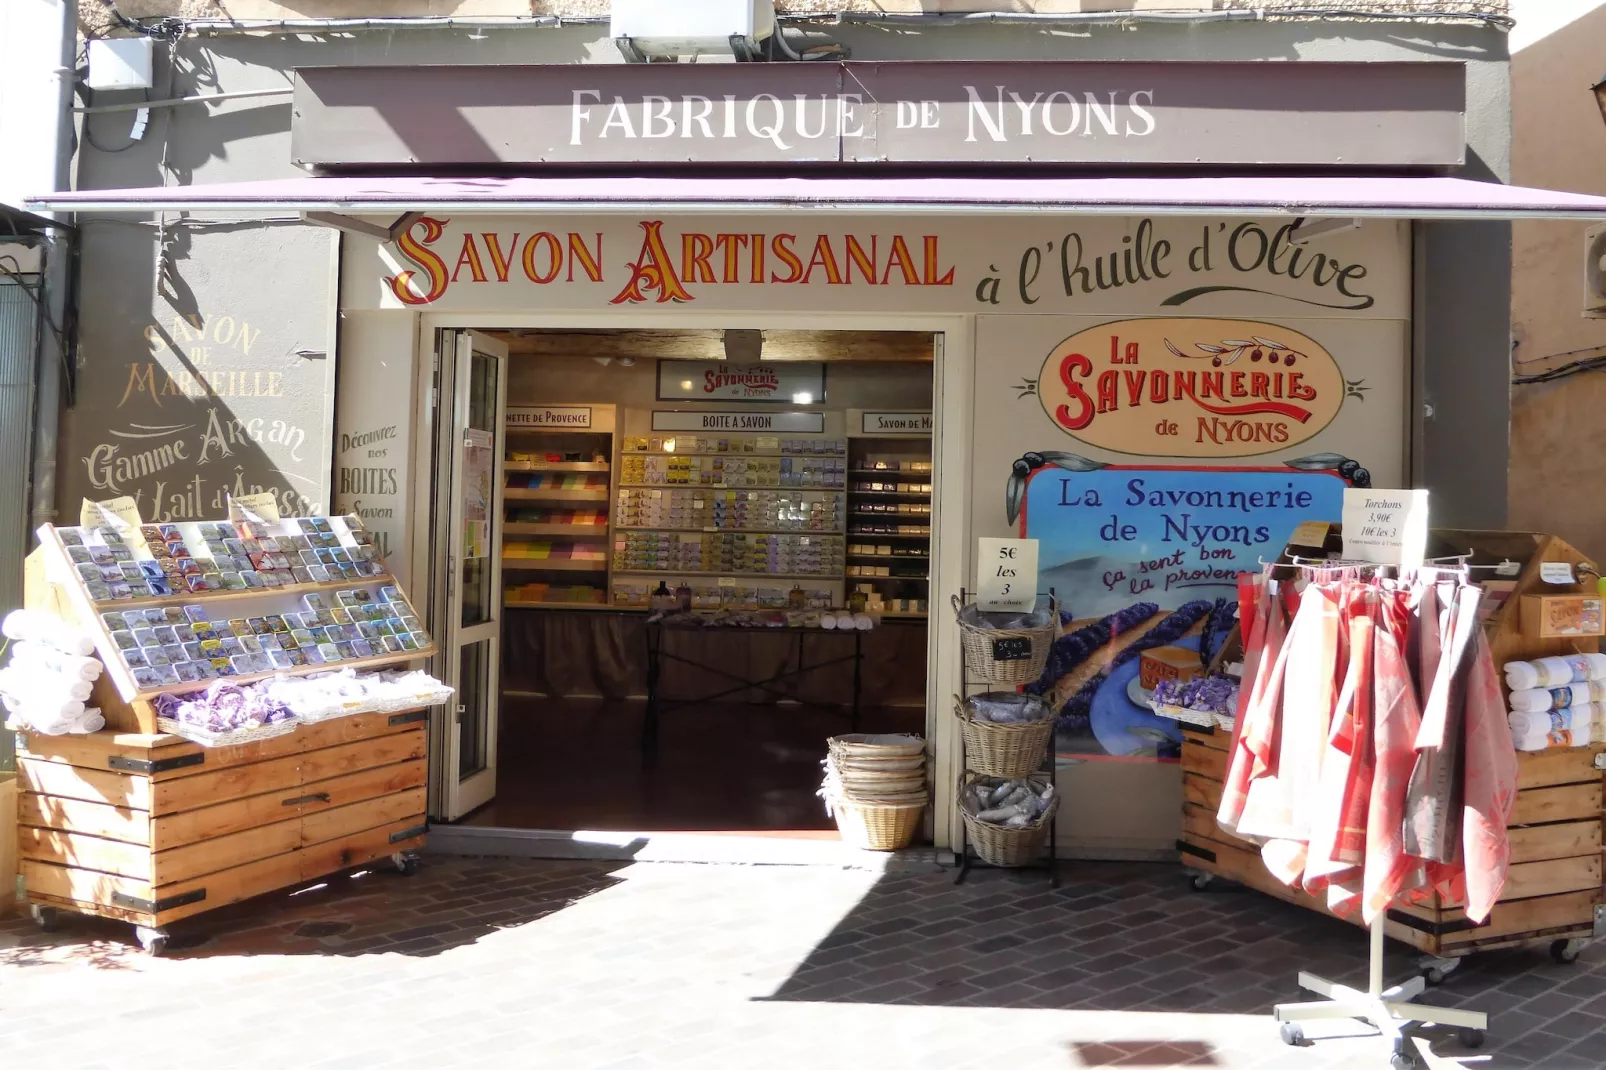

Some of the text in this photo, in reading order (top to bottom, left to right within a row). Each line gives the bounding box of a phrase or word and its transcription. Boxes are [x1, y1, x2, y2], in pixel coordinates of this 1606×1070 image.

[569, 85, 1157, 150] FABRIQUE DE NYONS
[383, 216, 955, 305] SAVON ARTISANAL
[976, 264, 1001, 304] à
[1019, 218, 1171, 304] l'huile
[144, 314, 262, 355] SAVON
[191, 347, 212, 364] DE
[116, 362, 284, 408] MARSEILLE
[703, 370, 779, 392] SAVONNERIE
[1055, 353, 1317, 430] SAVONNERIE
[744, 388, 771, 397] NYONS
[533, 414, 543, 423] DE
[545, 411, 587, 423] PROVENCE
[703, 415, 771, 428] BOITE A SAVON
[878, 417, 906, 428] SAVON
[908, 420, 919, 428] DE
[342, 425, 397, 453] Découvrez
[1155, 416, 1289, 444] de NYONS
[368, 448, 388, 458] nos
[82, 439, 190, 494] Gamme
[340, 467, 397, 495] BOITES
[151, 474, 207, 523] Lait
[1058, 478, 1312, 512] La Savonnerie
[1364, 498, 1403, 509] Torchons
[353, 500, 393, 519] Savon
[1368, 512, 1393, 523] 3,90€
[1100, 515, 1137, 542] de
[1160, 513, 1270, 547] Nyons
[1360, 526, 1397, 538] 10€ les 3
[999, 547, 1017, 559] 5€
[996, 565, 1017, 577] les
[1103, 545, 1236, 591] ça sent bon
[1001, 583, 1011, 595] 3
[1130, 577, 1154, 594] la
